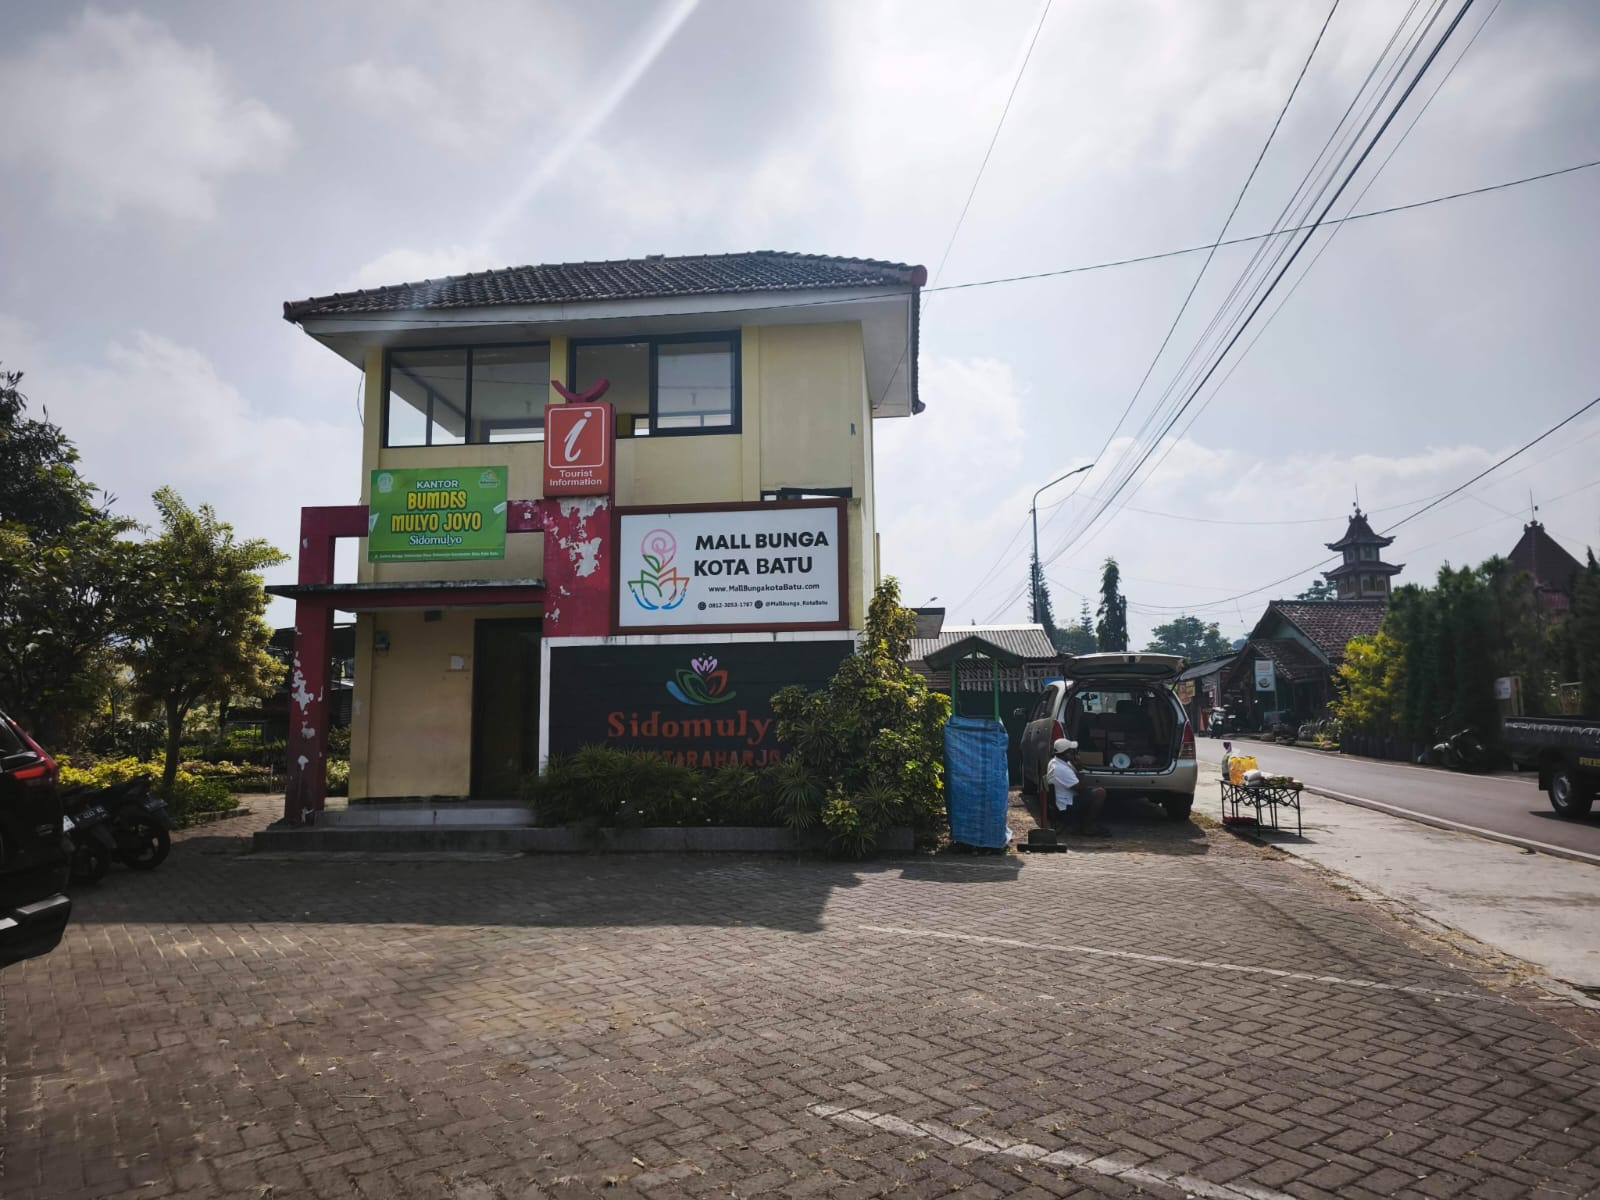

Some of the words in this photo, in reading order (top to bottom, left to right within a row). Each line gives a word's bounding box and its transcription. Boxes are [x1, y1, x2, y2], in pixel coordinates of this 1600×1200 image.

[549, 478, 602, 487] Information
[560, 469, 592, 478] Tourist
[416, 480, 459, 489] KANTOR
[407, 491, 467, 510] BUMDES
[391, 514, 439, 532] MULYO
[443, 512, 482, 531] JOYO
[409, 535, 463, 546] Sidomulyo
[695, 534, 751, 550] MALL
[755, 531, 829, 548] BUNGA
[694, 559, 750, 576] KOTA
[756, 556, 813, 574] BATU
[608, 710, 774, 745] Sidomuly
